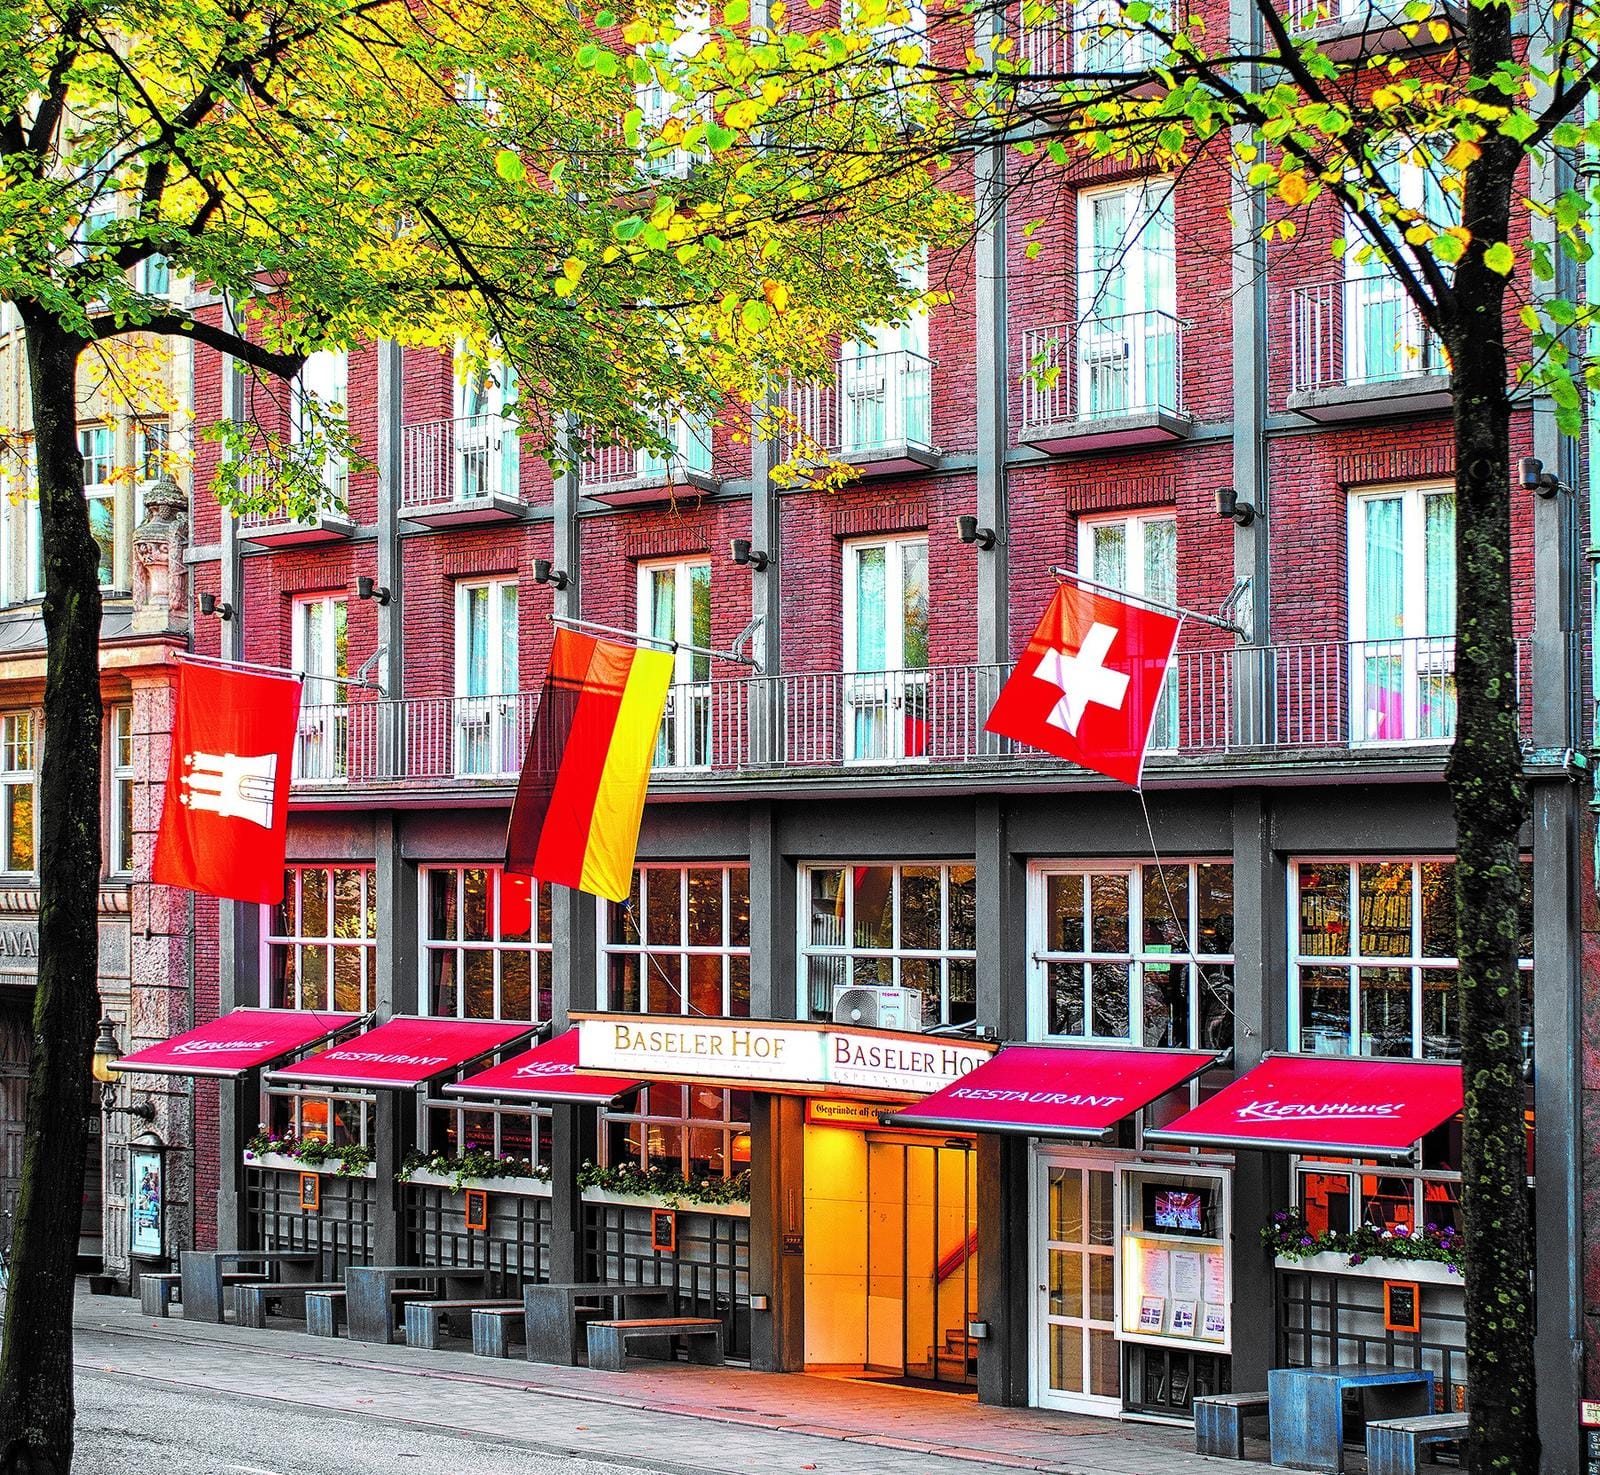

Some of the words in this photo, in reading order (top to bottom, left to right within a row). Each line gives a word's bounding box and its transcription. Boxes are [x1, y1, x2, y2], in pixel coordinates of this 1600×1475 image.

[614, 1024, 723, 1055] BASELER
[731, 1030, 786, 1058] HOF
[324, 1051, 448, 1066] RESTAURANT
[835, 1037, 935, 1074] BASELER
[949, 1088, 1124, 1108] RESTAURANT
[815, 1104, 857, 1117] Gegründet
